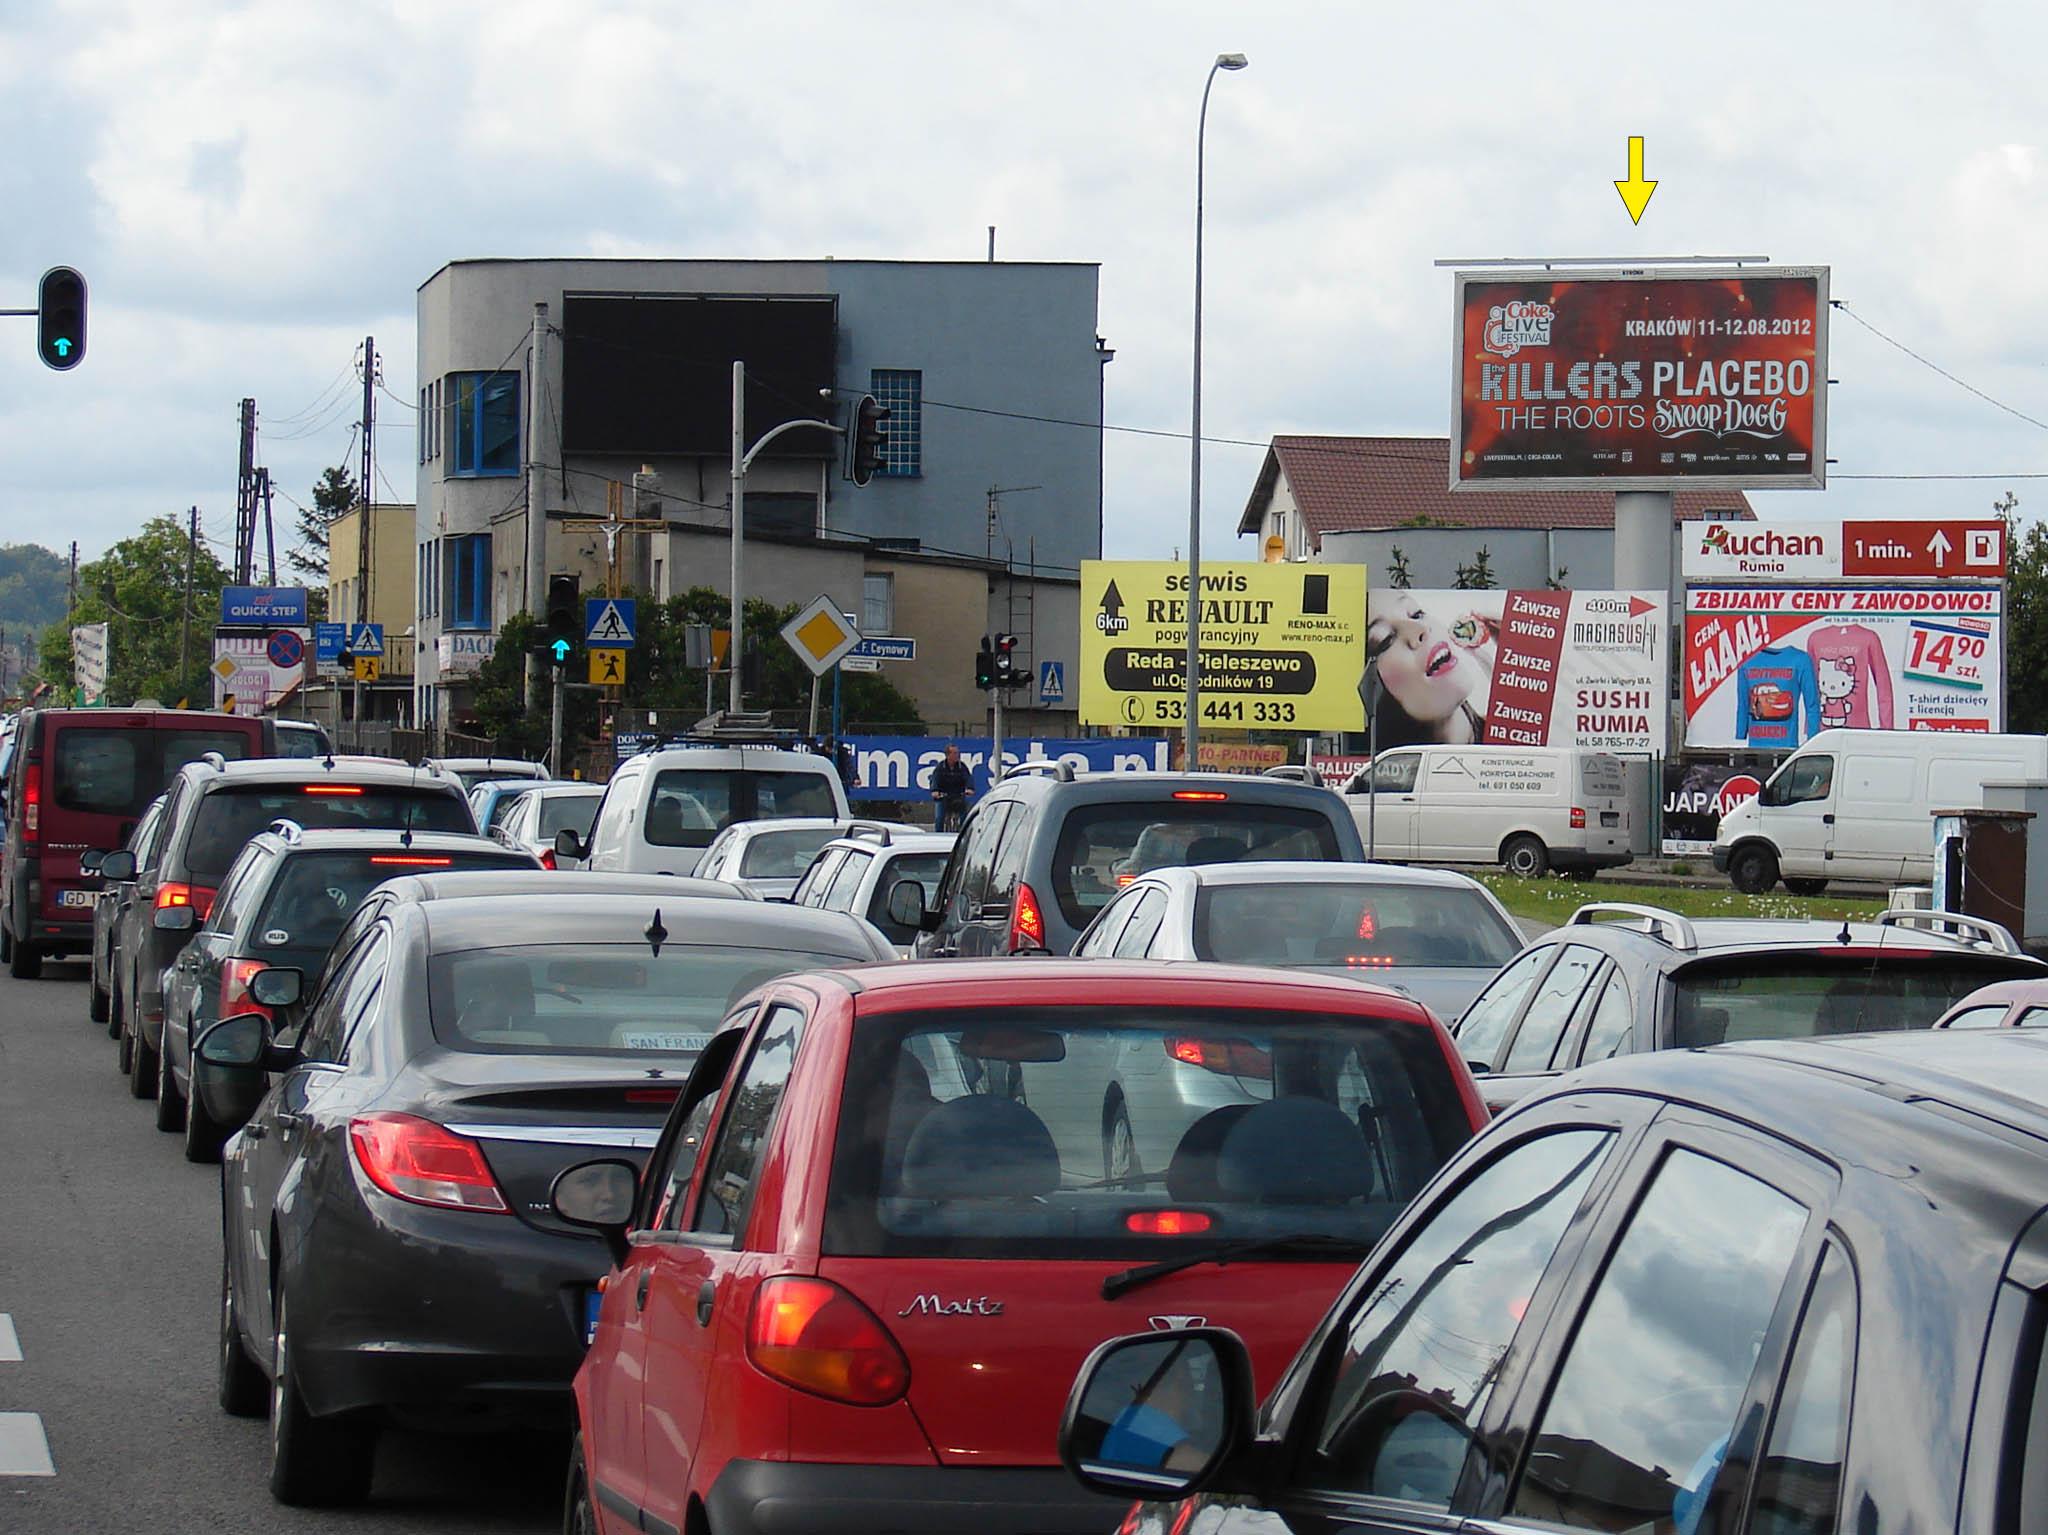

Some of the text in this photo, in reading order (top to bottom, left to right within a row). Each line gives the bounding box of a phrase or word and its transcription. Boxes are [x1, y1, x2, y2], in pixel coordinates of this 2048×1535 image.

[1507, 302, 1549, 319] Coke
[1502, 310, 1549, 332] Live
[1625, 315, 1811, 337] KRAKÓW 11-12.08.2012
[1501, 332, 1548, 343] FESTIVAL
[1491, 364, 1506, 373] the
[1481, 360, 1810, 401] KILLERS PLACEBO
[1496, 406, 1546, 430] THE
[1555, 404, 1645, 430] ROOTS
[1701, 525, 1824, 556] Auchan
[1854, 539, 1912, 559] 1 min.
[1739, 559, 1785, 573] Rumia
[1511, 595, 1561, 619] Zawsze
[1585, 598, 1630, 613] 400m
[1695, 591, 1993, 611] ZBIJAMY CENY ZAWODOWO!
[231, 606, 298, 617] QUICK STEP
[1096, 612, 1129, 631] 6km
[1287, 620, 1337, 630] RENO-MAX
[1155, 627, 1260, 646] pogwrancyjny
[1694, 618, 1721, 648] CENA
[870, 642, 910, 658] Ceynowy
[1910, 630, 1986, 673] 14 90
[1127, 652, 1174, 669] Reda
[1502, 648, 1552, 673] Zawsze
[1152, 673, 1274, 689] ul.Ogodników 19
[1955, 665, 1980, 679] szt.
[1498, 671, 1548, 693] zdrowo
[1576, 689, 1650, 709] SUSHI
[1908, 693, 1989, 707] T-shirt dziecięcy
[1156, 699, 1296, 723] 53 441 333
[1494, 701, 1543, 725] Zawsze
[1909, 704, 1955, 716] z licencją
[1576, 714, 1650, 734] RUMIA
[1490, 725, 1542, 746] na czas!
[1591, 736, 1603, 747] 58
[66, 891, 86, 905] GD
[630, 1038, 659, 1049] SAN
[898, 1294, 1004, 1316] Matiz
